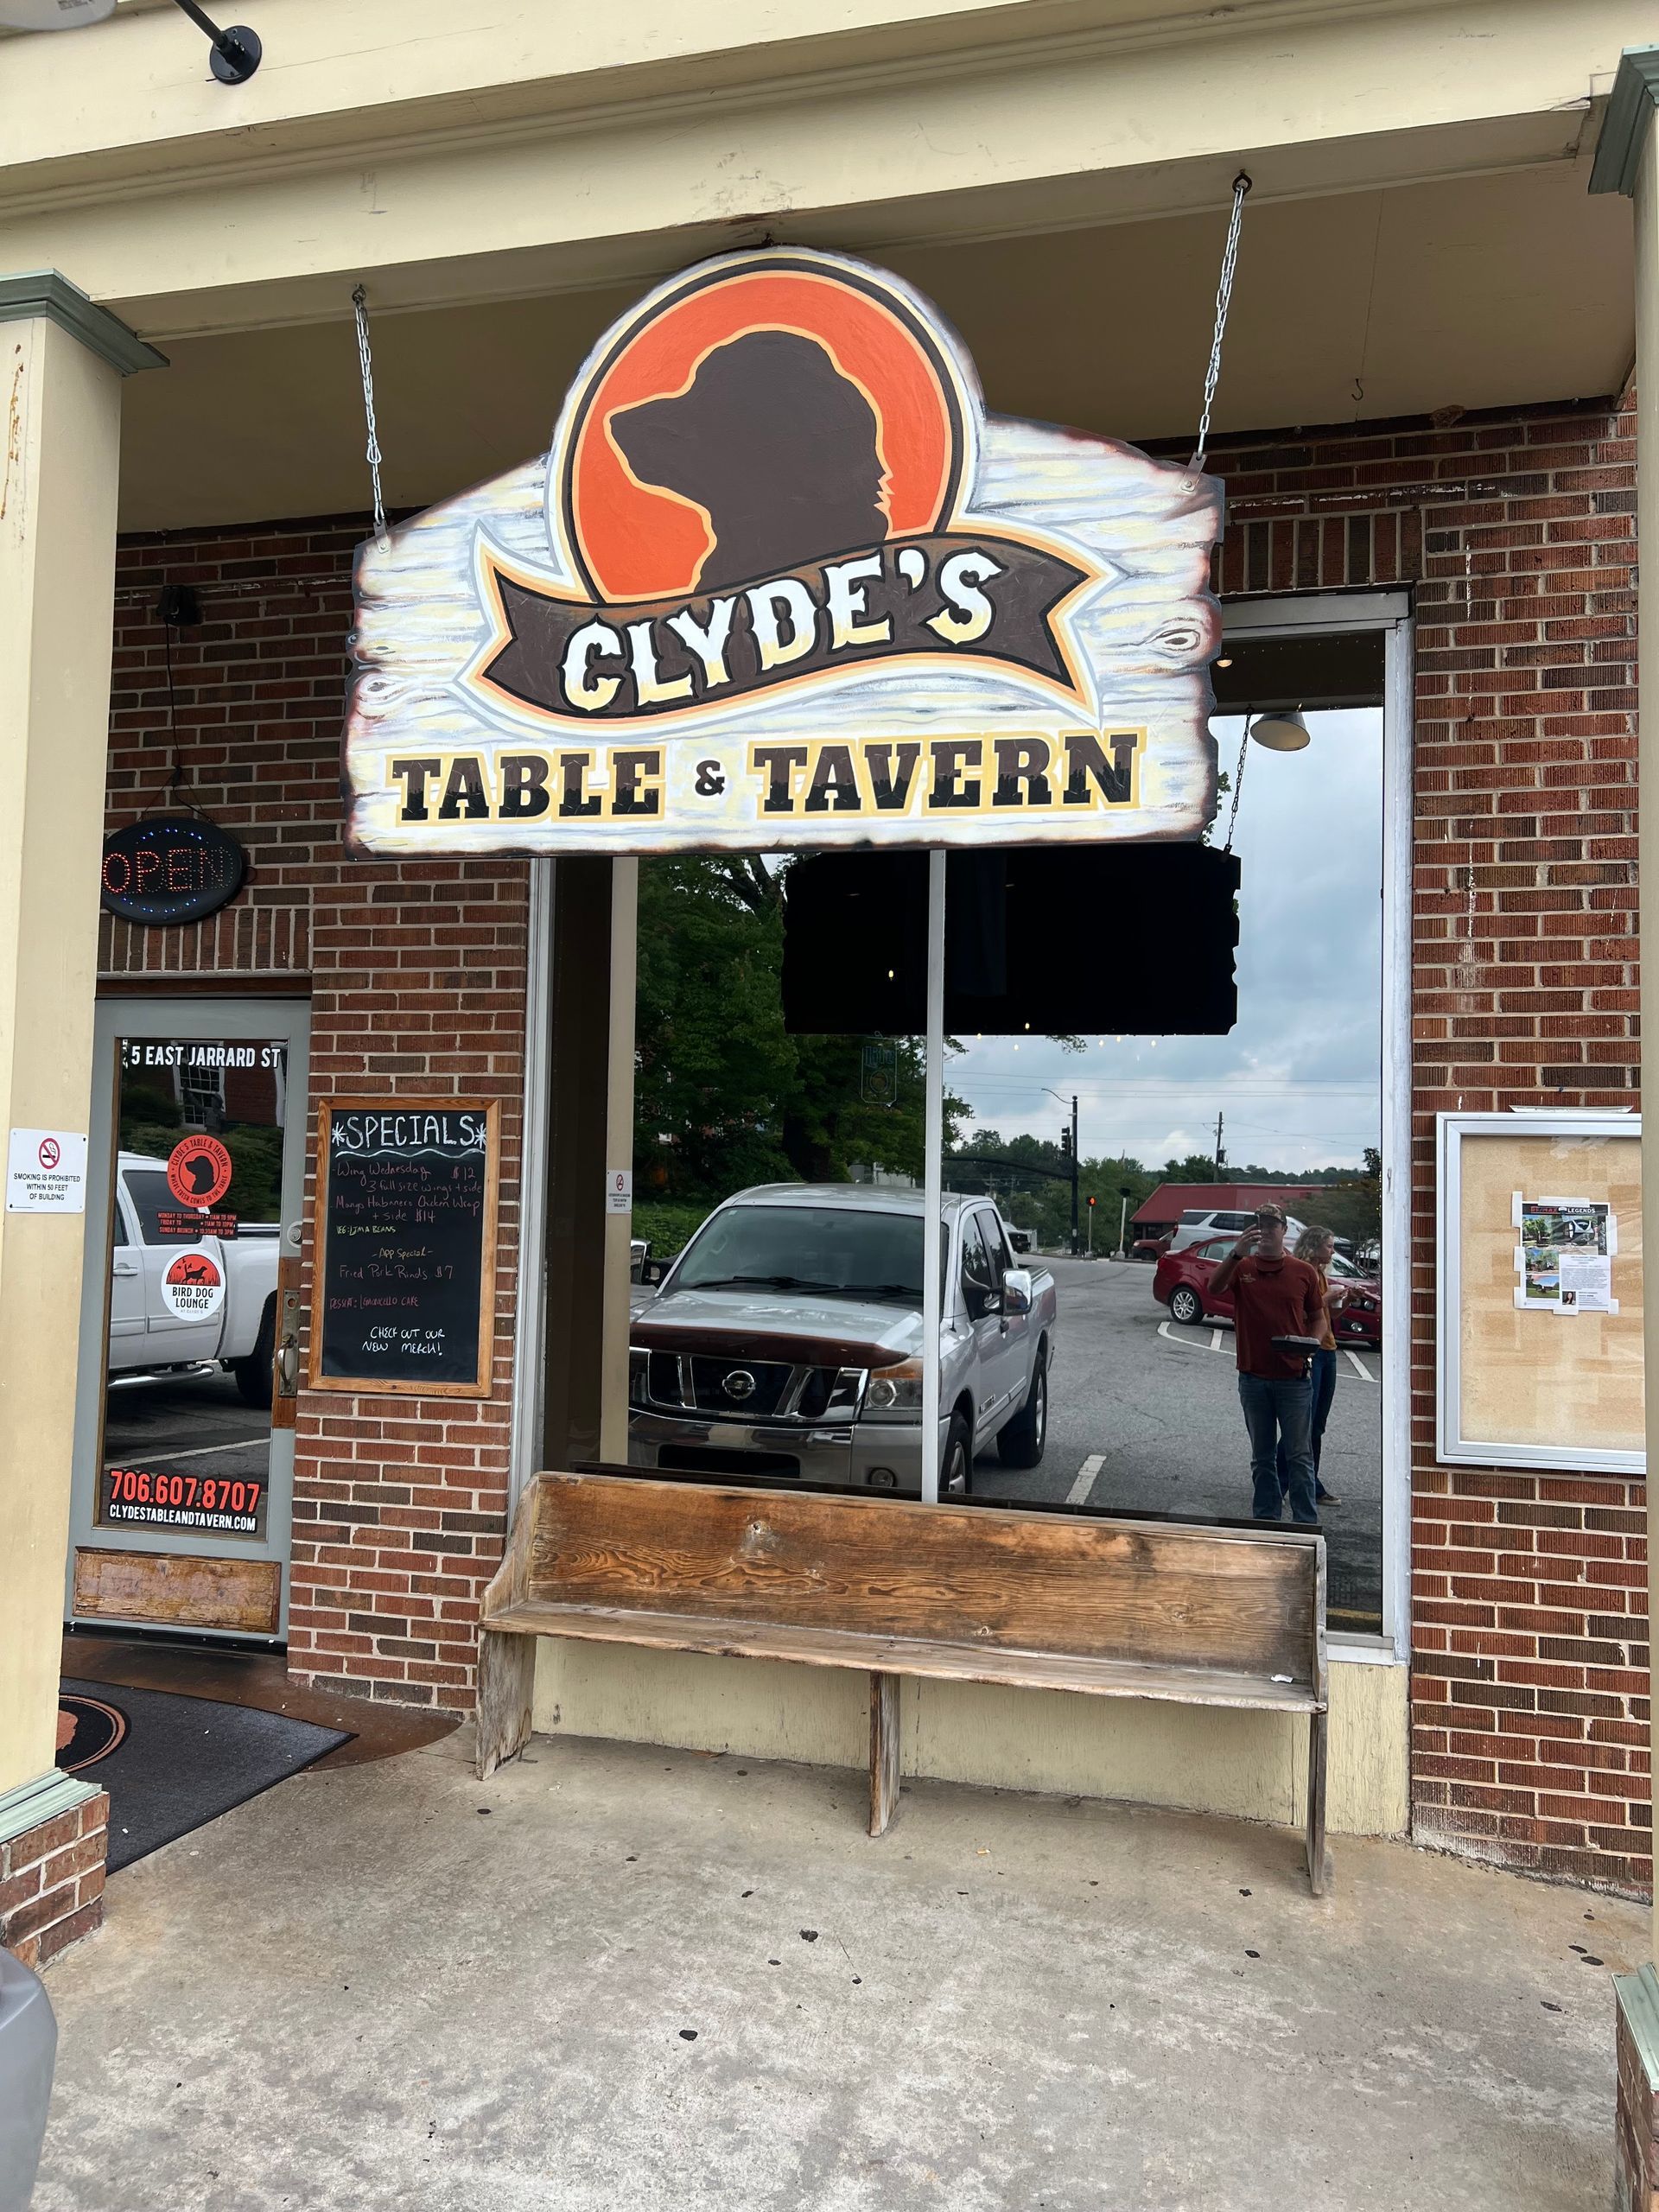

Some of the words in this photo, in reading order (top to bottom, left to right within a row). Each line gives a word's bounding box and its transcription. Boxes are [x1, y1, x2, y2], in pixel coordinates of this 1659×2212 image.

[562, 548, 1003, 712] CLYDE'S
[394, 750, 660, 820] TABLE
[695, 760, 726, 796] &
[753, 734, 1141, 814] TAVERN
[103, 847, 223, 893] OPEN
[131, 1046, 141, 1065] 5
[145, 1046, 183, 1065] EAST
[188, 1047, 256, 1067] JARRARD
[261, 1048, 281, 1068] ST
[346, 1116, 475, 1149] SPECIALS
[189, 1138, 207, 1148] TABLE
[213, 1144, 229, 1167] TAVERN
[14, 1173, 41, 1181] SMOKING
[48, 1174, 80, 1183] PROHIBITED
[369, 1161, 432, 1181] Wednesday
[450, 1166, 475, 1180] $12
[366, 1180, 377, 1192] 3
[383, 1210, 408, 1222] side
[415, 1209, 436, 1224] $14
[453, 1198, 481, 1217] Wrap
[340, 1264, 364, 1280] Fried
[367, 1263, 393, 1278] Pork
[435, 1265, 453, 1280] $7
[172, 1287, 192, 1297] BIRD
[195, 1287, 213, 1298] DOG
[175, 1298, 209, 1308] LOUNGE
[370, 1326, 398, 1339] CHECK
[400, 1328, 421, 1339] OUT
[425, 1328, 446, 1339] OUR
[361, 1341, 389, 1352] NEW
[401, 1342, 443, 1356] MERCH!
[111, 1471, 260, 1512] 706.607.8707
[109, 1504, 257, 1531] CLYDESTABLEANDTAVERN.COM
